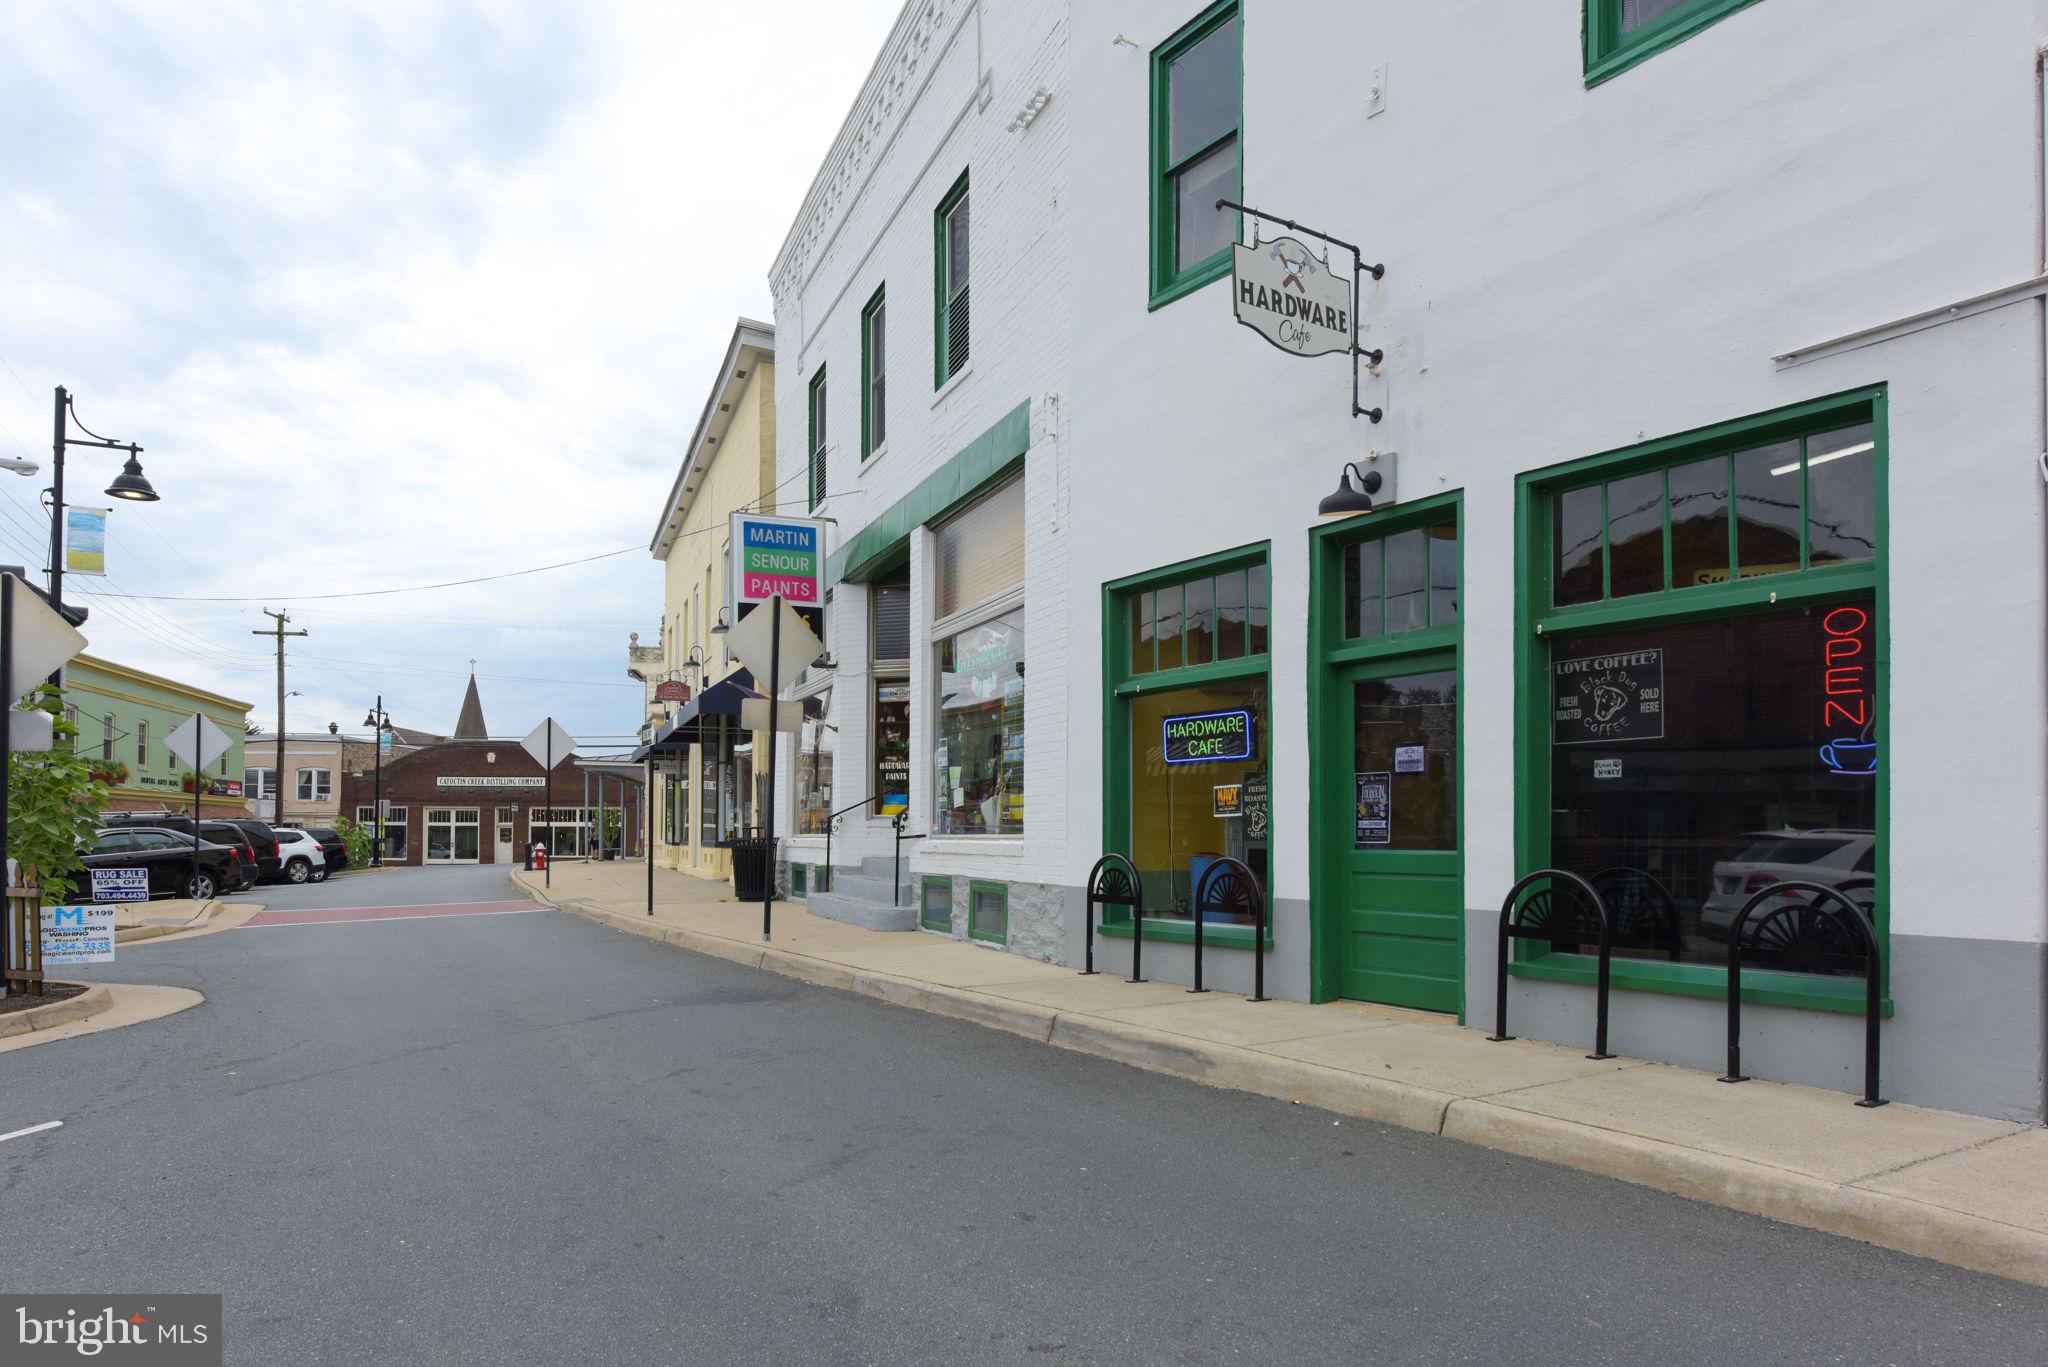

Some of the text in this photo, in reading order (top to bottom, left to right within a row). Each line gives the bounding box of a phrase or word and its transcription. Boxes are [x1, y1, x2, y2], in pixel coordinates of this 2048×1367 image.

[1239, 278, 1348, 334] HARDWARE
[1278, 319, 1312, 350] Cafe
[750, 528, 809, 546] MARTIN
[752, 553, 809, 571] SENOUR
[751, 578, 809, 597] PAINTS
[1556, 651, 1658, 675] LOVE COFFEE?
[1824, 608, 1866, 727] OPEN
[1580, 670, 1637, 694] Black Dog
[1560, 696, 1578, 707] FRESH
[1640, 688, 1659, 699] SOLD
[1556, 708, 1582, 720] ROASTED
[1640, 701, 1660, 713] HERE
[1167, 716, 1244, 739] HARDWARE
[1188, 738, 1223, 756] CAFE
[886, 773, 907, 781] PAINTS
[1217, 787, 1238, 801] NAVY
[95, 870, 145, 879] RUG SALE
[95, 892, 147, 900] 703.494.4439
[87, 909, 114, 917] $199
